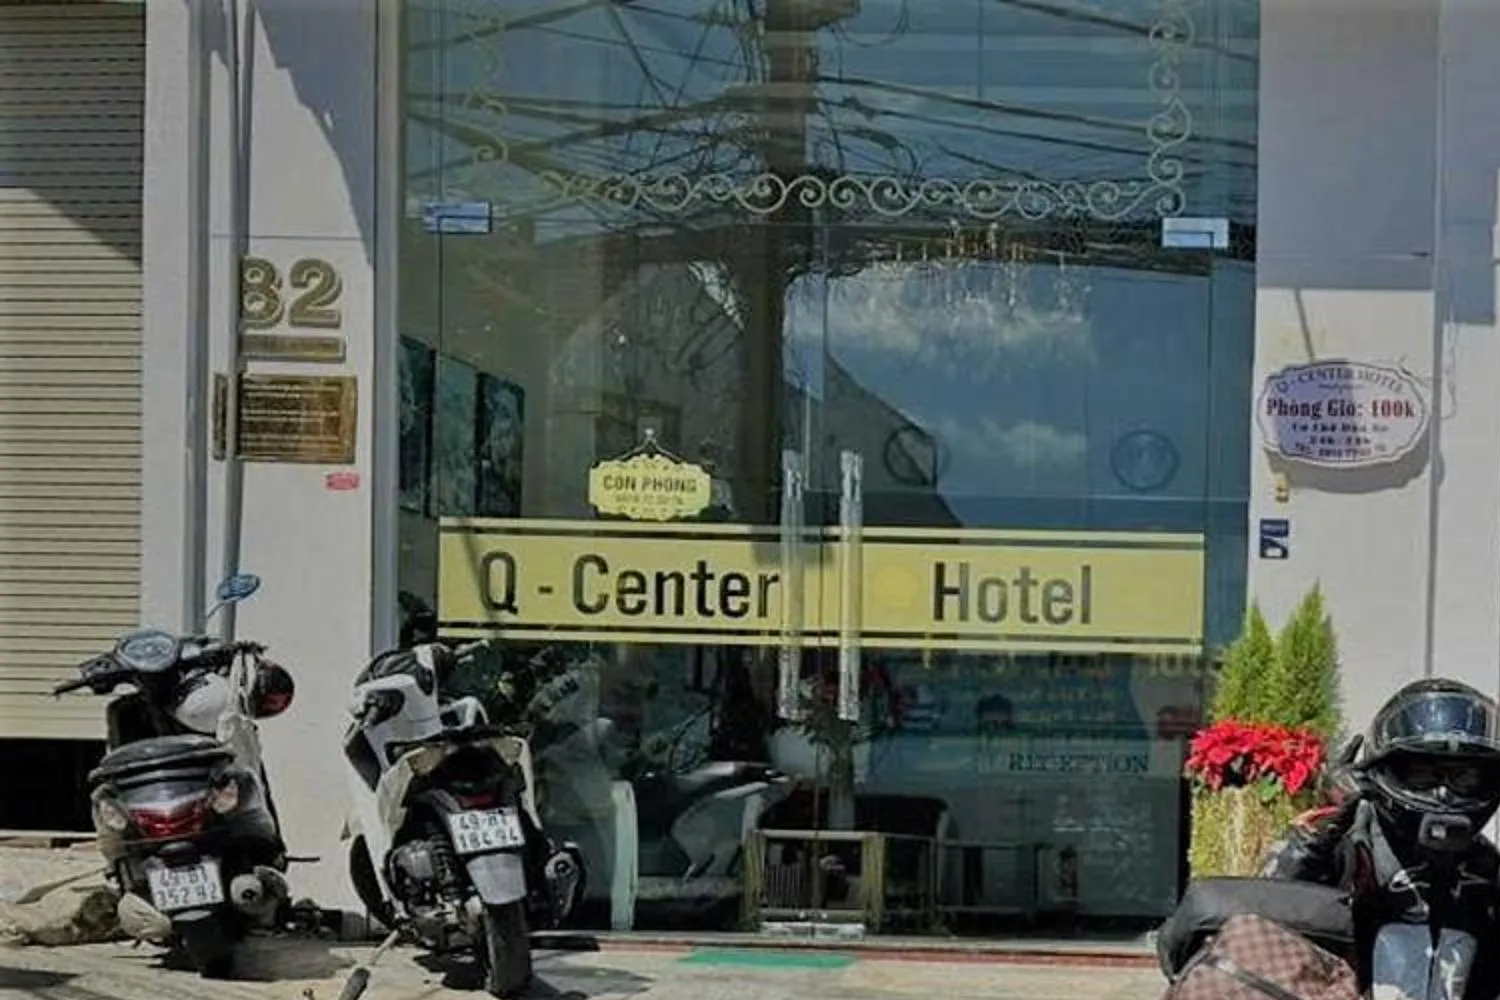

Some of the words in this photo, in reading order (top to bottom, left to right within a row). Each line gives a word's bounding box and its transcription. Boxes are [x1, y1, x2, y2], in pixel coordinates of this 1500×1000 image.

[240, 257, 343, 329] 82
[1371, 397, 1416, 418] 100k
[477, 550, 519, 616] Q
[571, 552, 780, 619] Center
[932, 560, 1093, 627] Hotel
